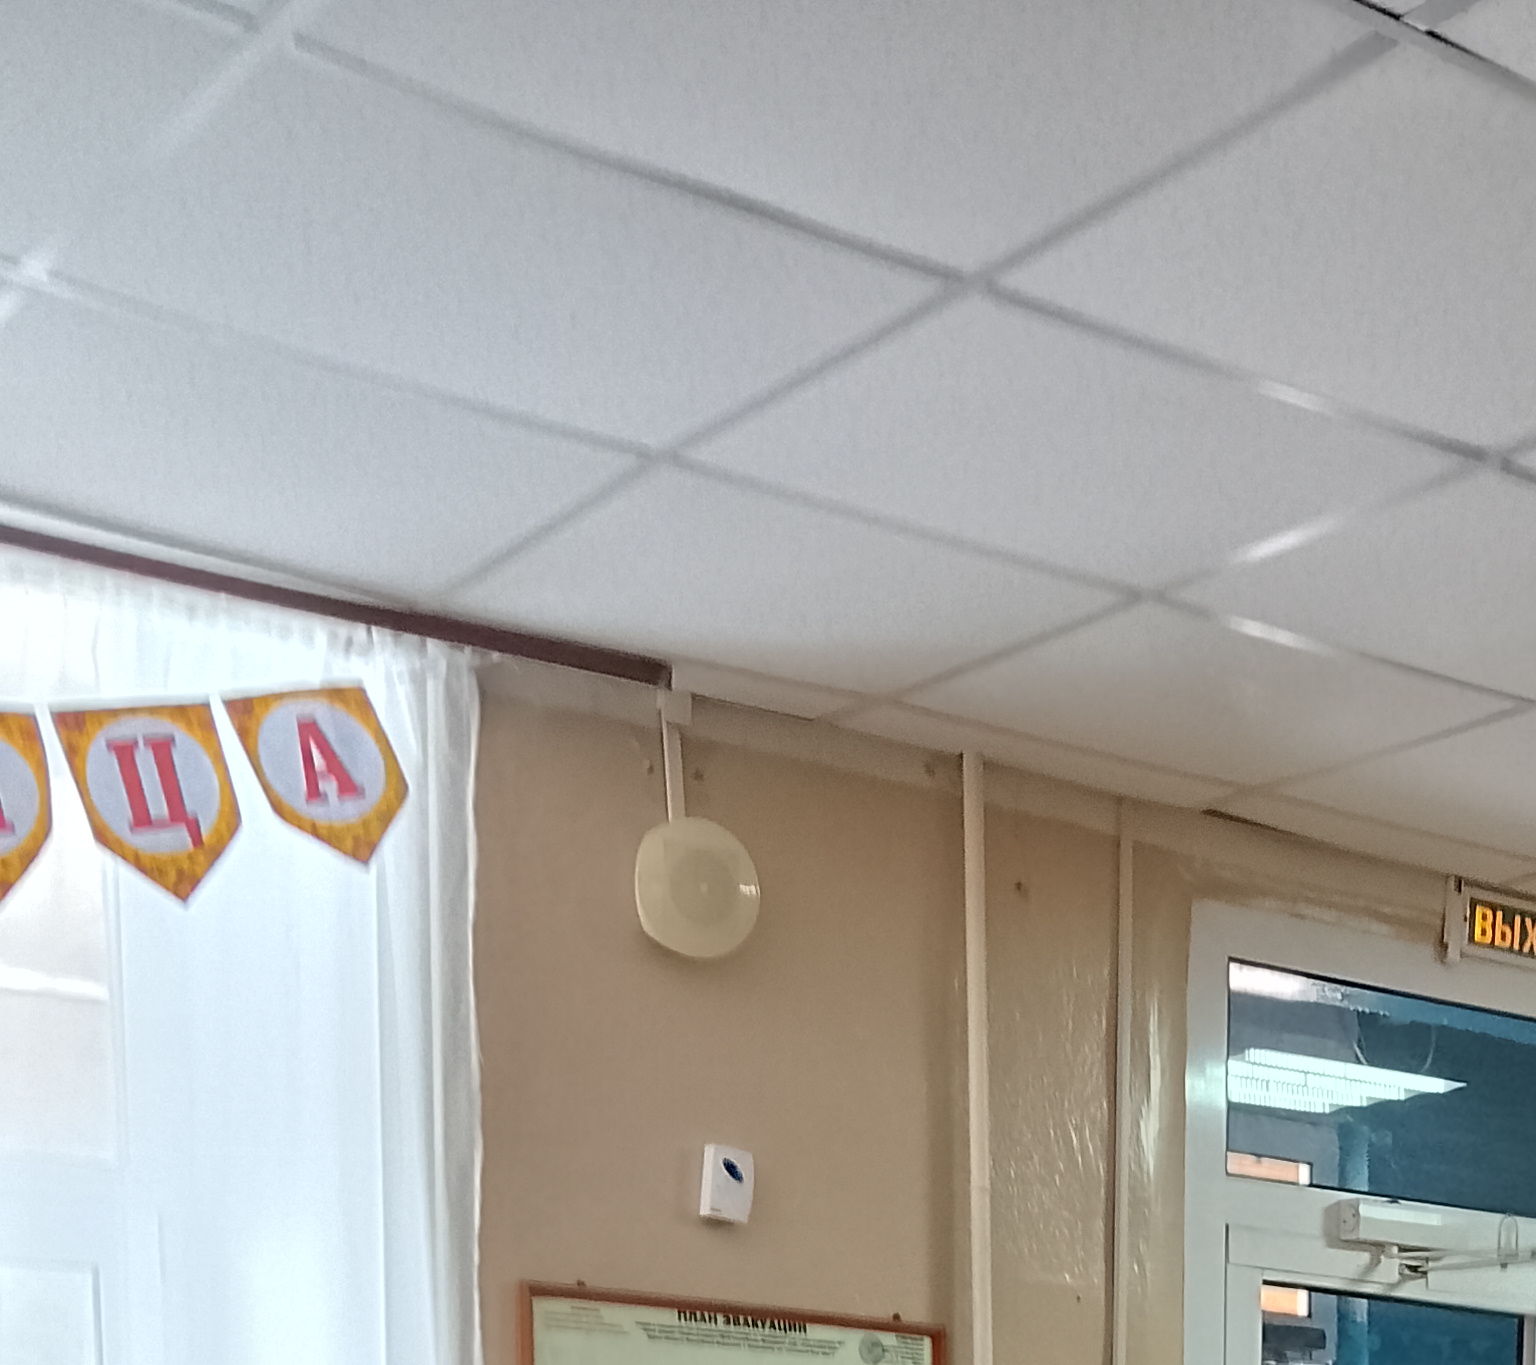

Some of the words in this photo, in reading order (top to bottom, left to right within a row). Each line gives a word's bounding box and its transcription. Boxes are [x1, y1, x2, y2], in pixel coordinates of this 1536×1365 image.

[0, 714, 365, 848] ЦА
[677, 1309, 718, 1326] ПЛАН
[723, 1314, 807, 1336] ЭВАКУАЦИИ
